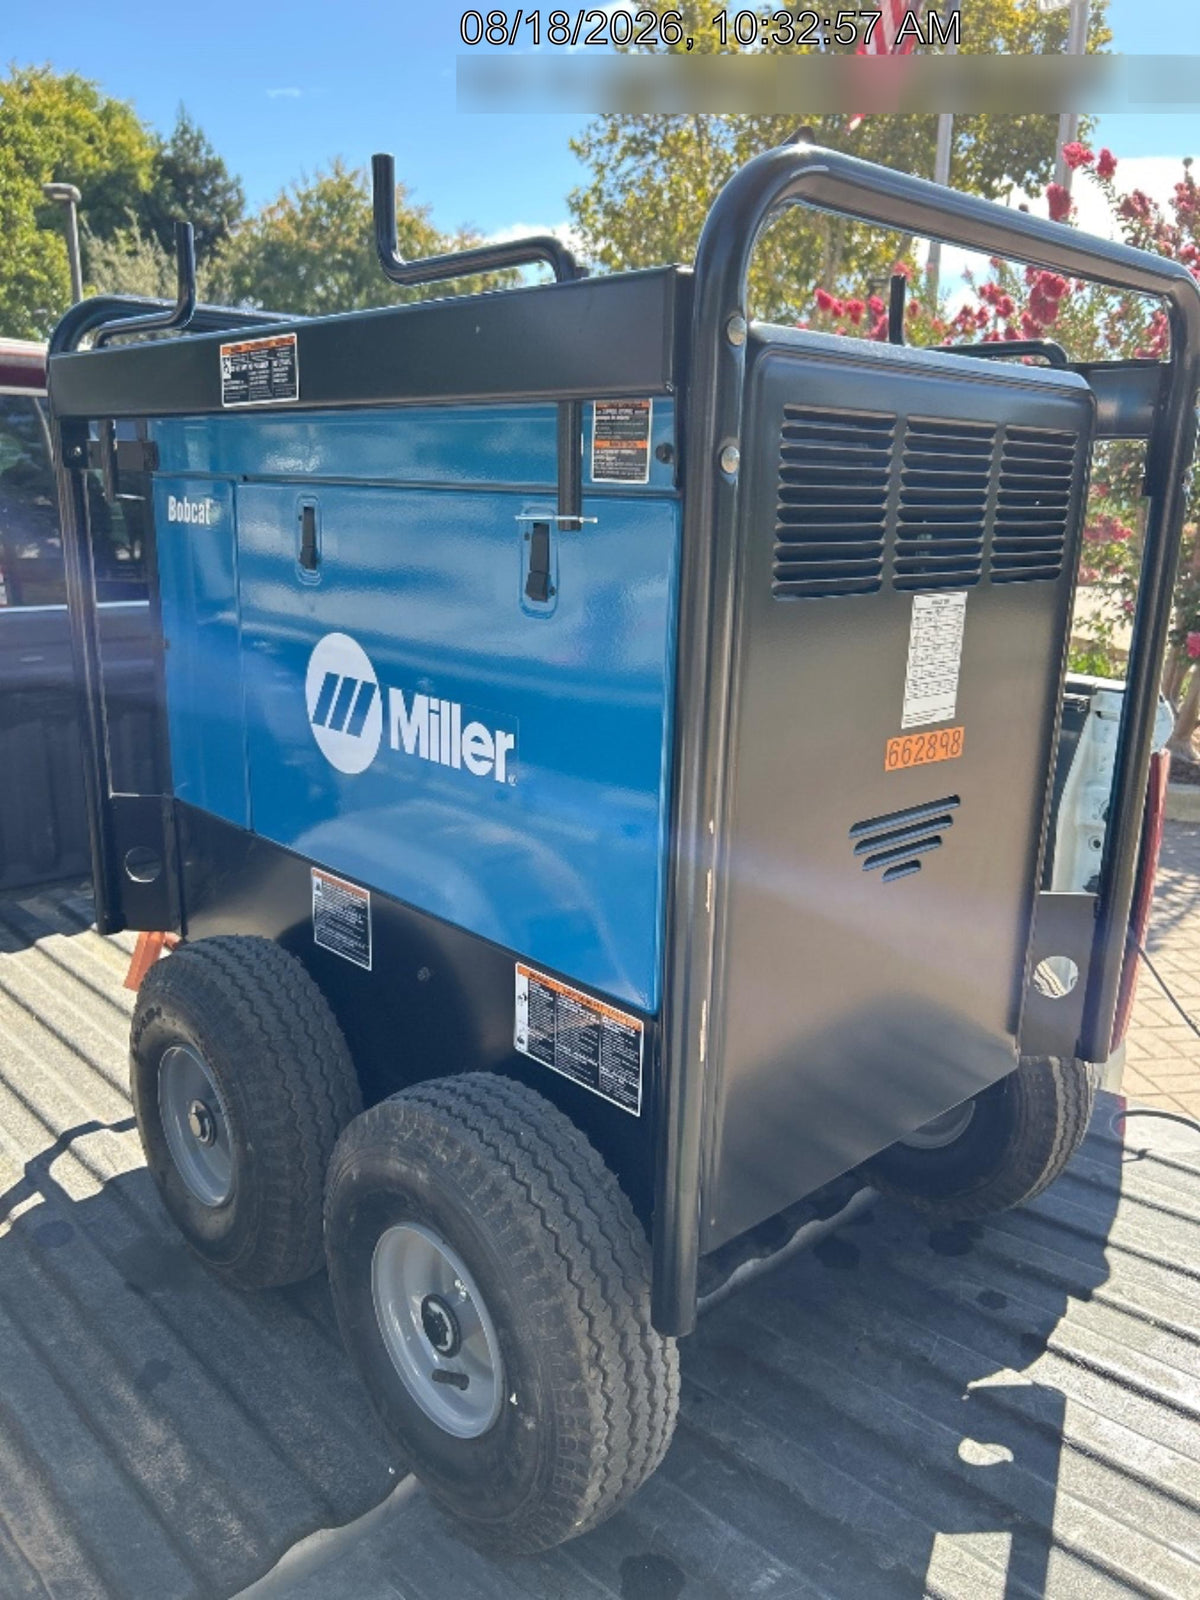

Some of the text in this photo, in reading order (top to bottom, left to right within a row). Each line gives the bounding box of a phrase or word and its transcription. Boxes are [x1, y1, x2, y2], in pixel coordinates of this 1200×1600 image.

[168, 495, 211, 525] Bobcat
[388, 687, 514, 784] Miller
[888, 729, 962, 768] 662898
